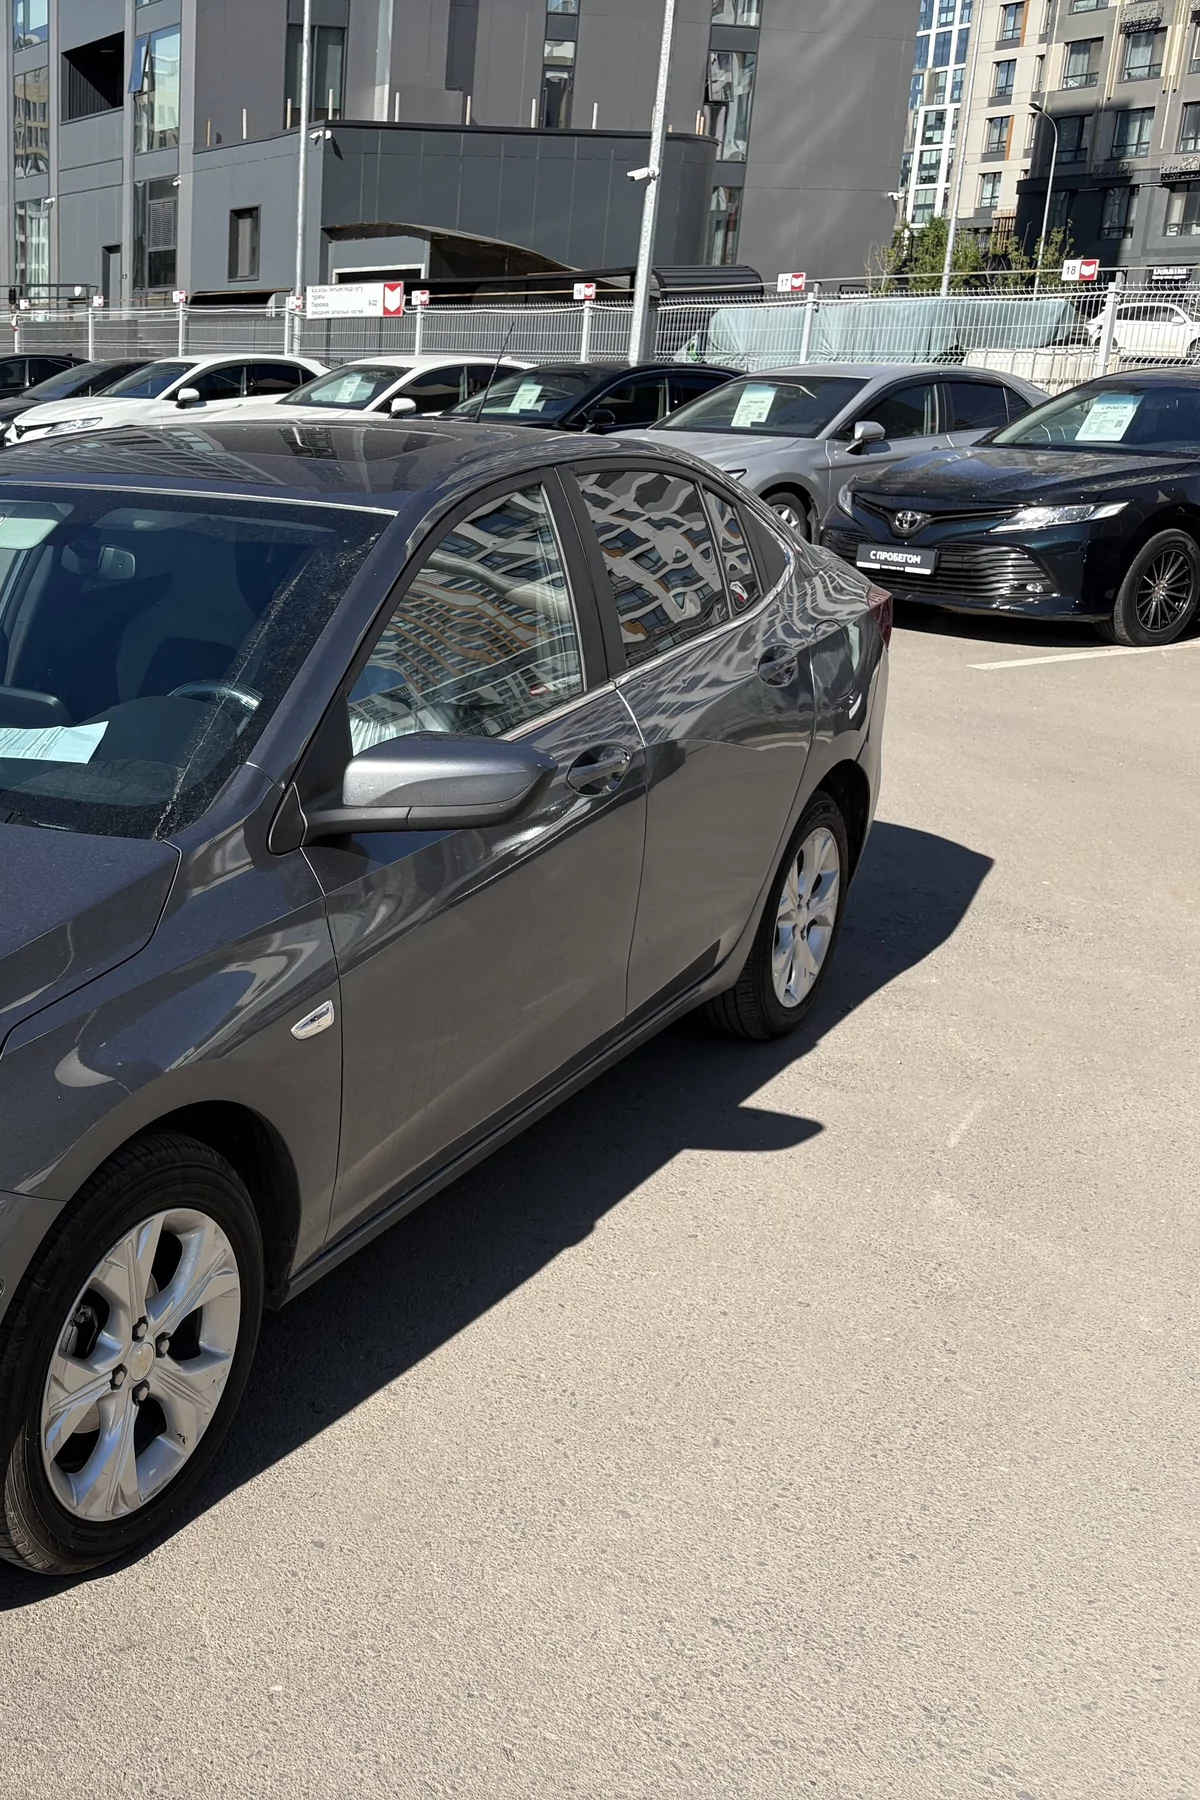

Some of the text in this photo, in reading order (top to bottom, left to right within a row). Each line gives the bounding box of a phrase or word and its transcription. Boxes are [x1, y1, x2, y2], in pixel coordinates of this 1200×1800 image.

[1065, 265, 1077, 275] 18
[781, 278, 789, 287] 17
[869, 550, 921, 565] С ПРОБЕГОМ
